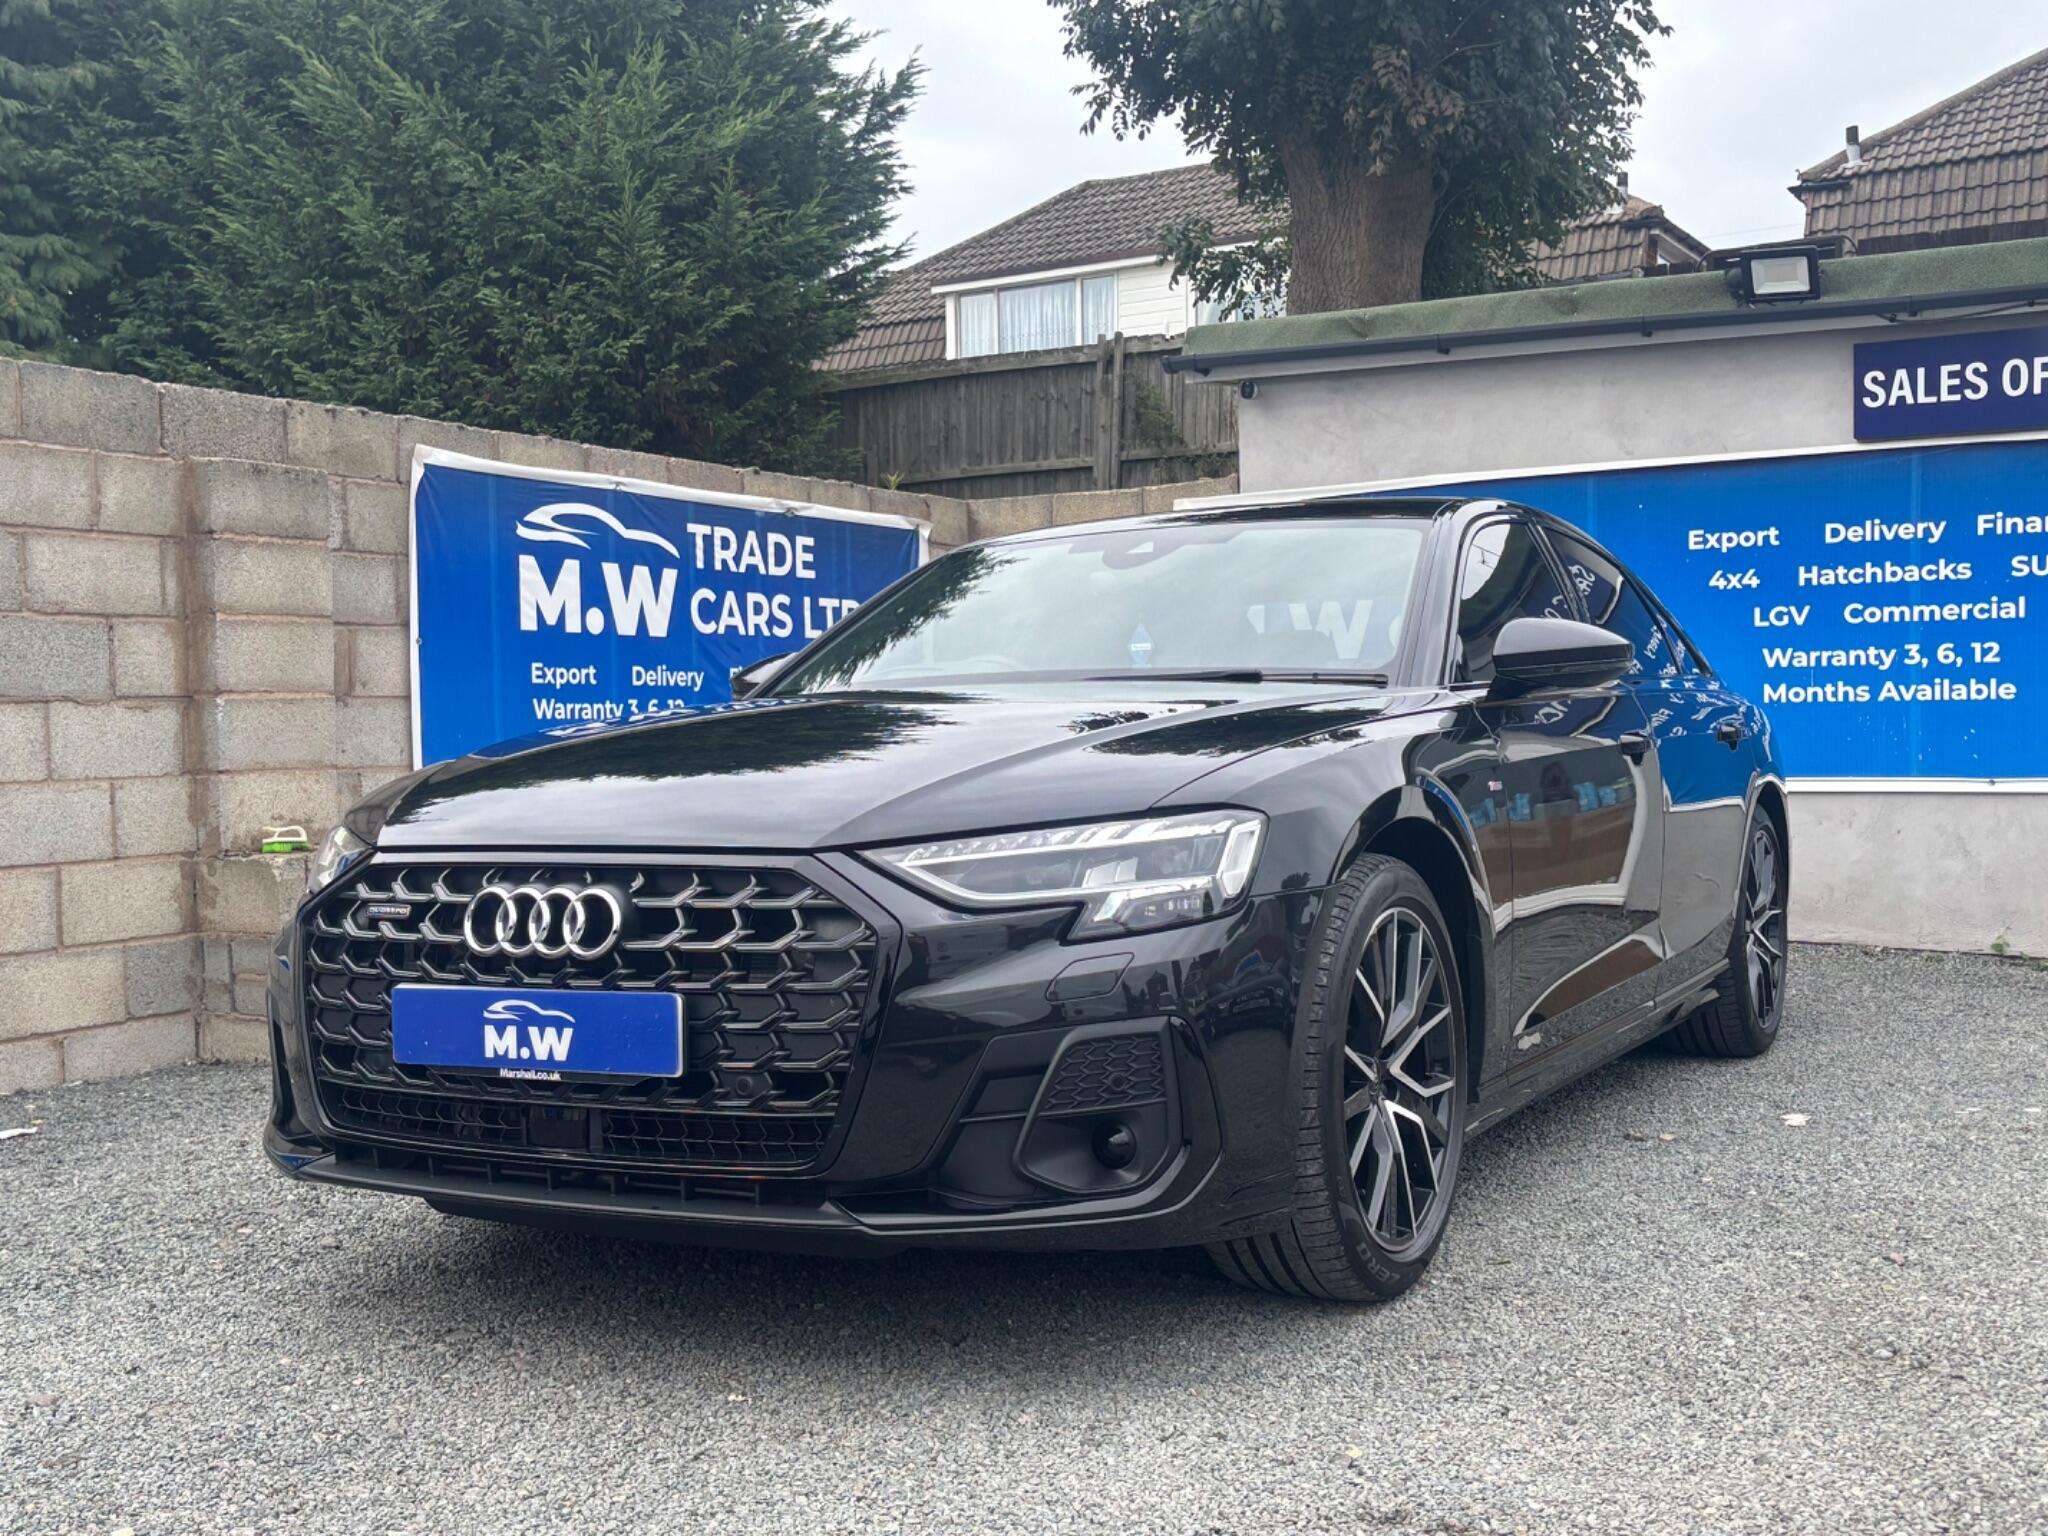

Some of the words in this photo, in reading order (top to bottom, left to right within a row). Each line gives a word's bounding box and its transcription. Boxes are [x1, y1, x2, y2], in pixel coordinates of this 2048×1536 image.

[1862, 361, 1989, 408] SALES
[1688, 527, 1780, 553] Export
[1825, 518, 1947, 544] Delivery
[1977, 511, 2048, 536] Fina
[686, 522, 817, 579] TRADE
[1708, 569, 1761, 590] 4x4
[1798, 558, 1973, 587] Hatchbacks
[518, 554, 679, 638] M.W
[690, 587, 794, 638] CARS
[1753, 605, 1810, 628] LGV
[1843, 595, 2026, 624] Commercial
[1762, 646, 1897, 671] Warranty
[1904, 643, 1929, 668] 3,
[1937, 643, 1963, 667] 6,
[1970, 641, 2001, 663] 12
[531, 662, 597, 689] Export
[632, 664, 705, 692] Delivery
[1763, 680, 1871, 704] Months
[1878, 678, 2017, 701] Available
[532, 697, 624, 721] Warranty
[484, 1024, 573, 1062] M.W
